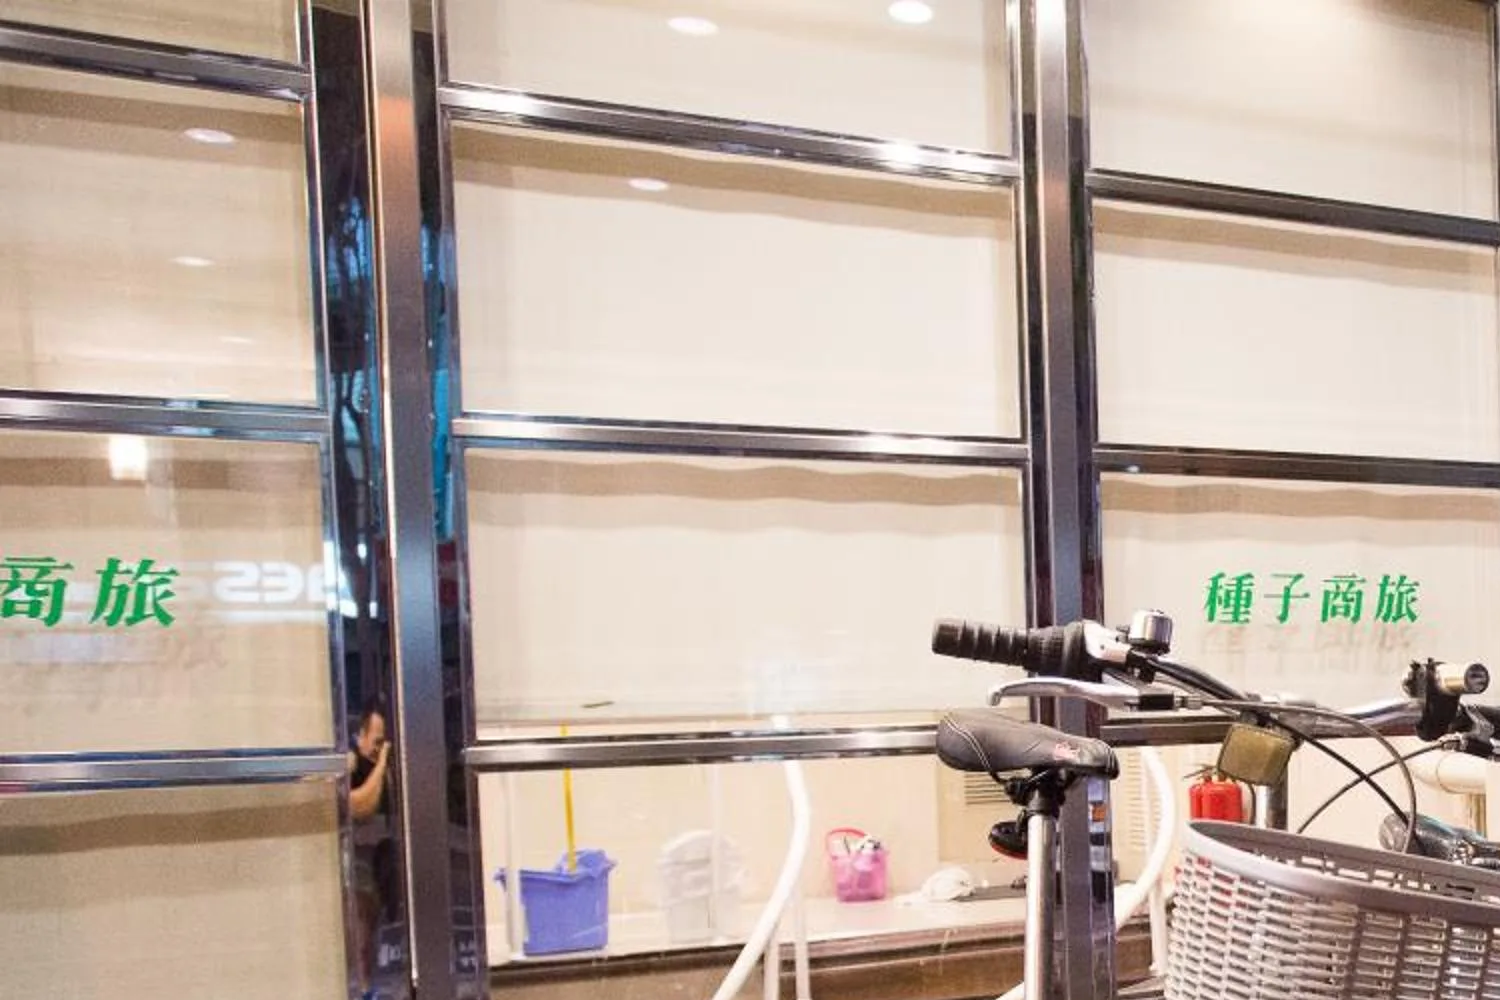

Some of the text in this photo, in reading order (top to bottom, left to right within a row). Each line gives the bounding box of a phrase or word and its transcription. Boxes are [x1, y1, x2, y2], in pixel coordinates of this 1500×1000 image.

[0, 556, 181, 628] 商旅
[1203, 571, 1421, 625] 種子商旅
